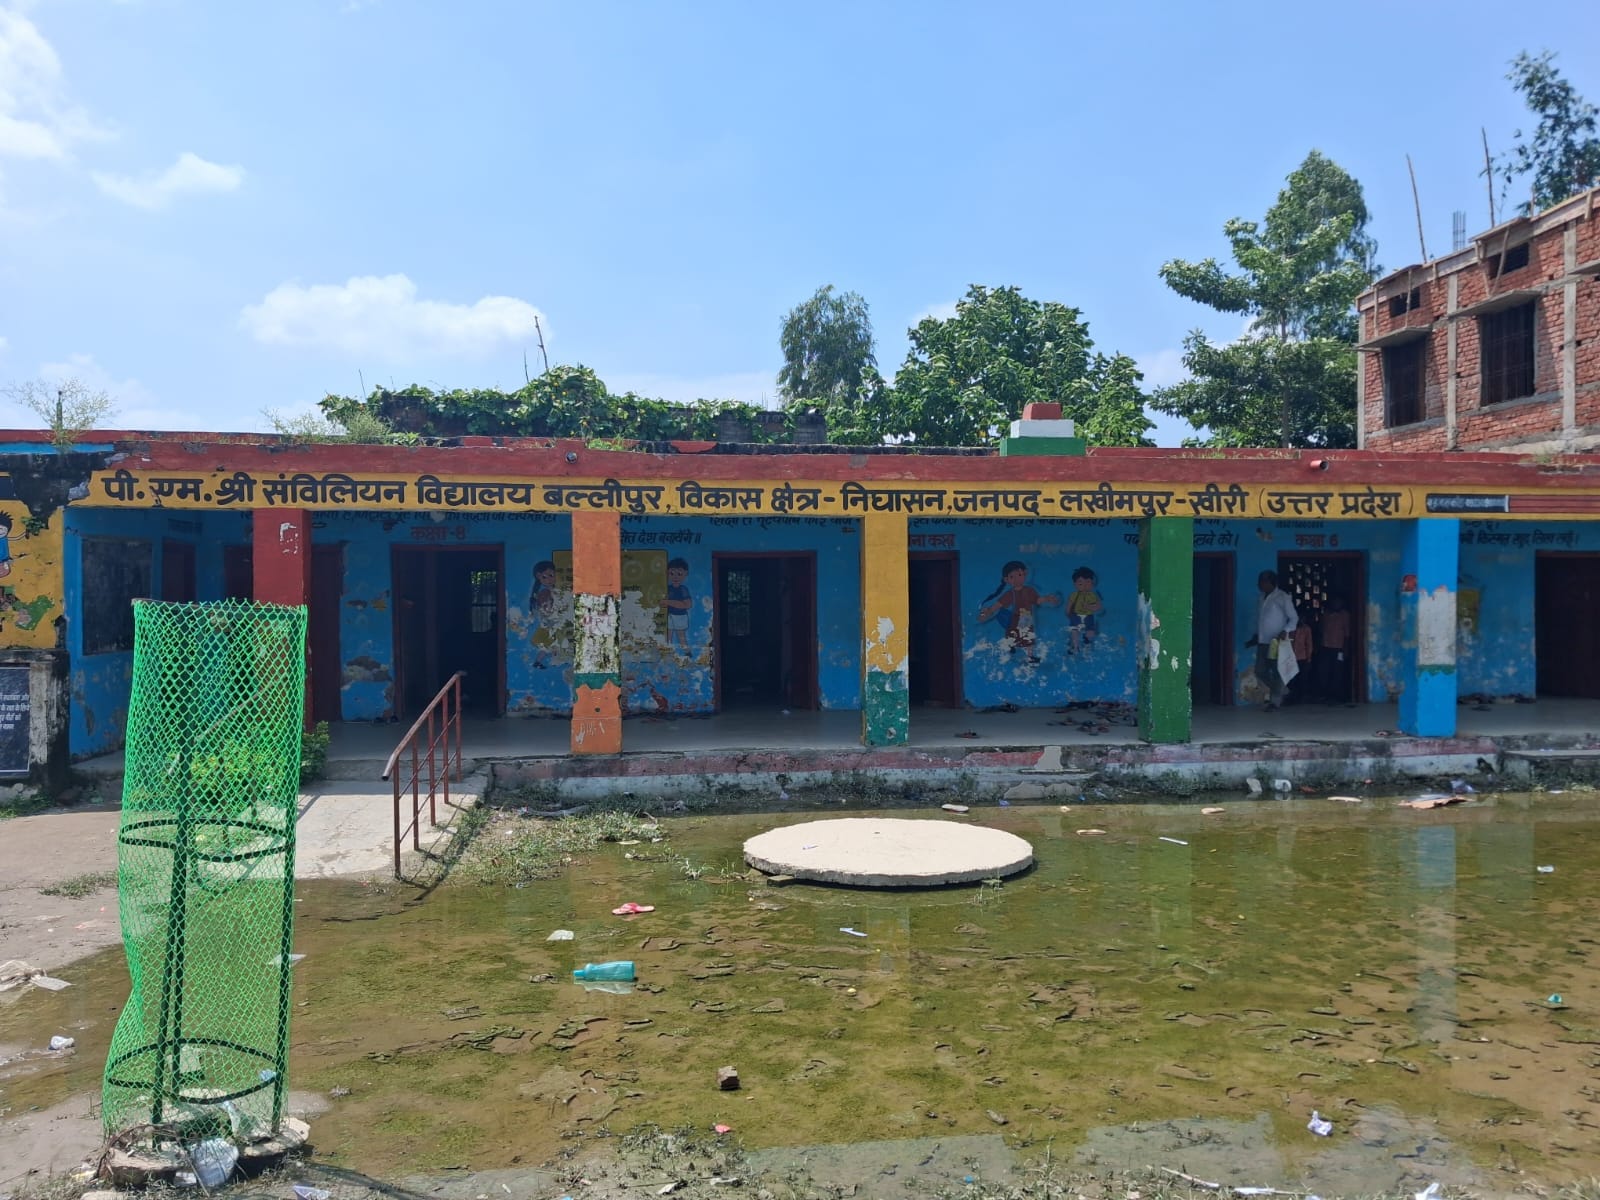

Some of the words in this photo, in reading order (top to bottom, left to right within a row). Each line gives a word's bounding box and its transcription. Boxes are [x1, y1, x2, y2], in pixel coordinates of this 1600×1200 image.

[262, 473, 407, 506] संविलियन
[414, 474, 536, 507] विद्यालय
[676, 480, 764, 510] विकास
